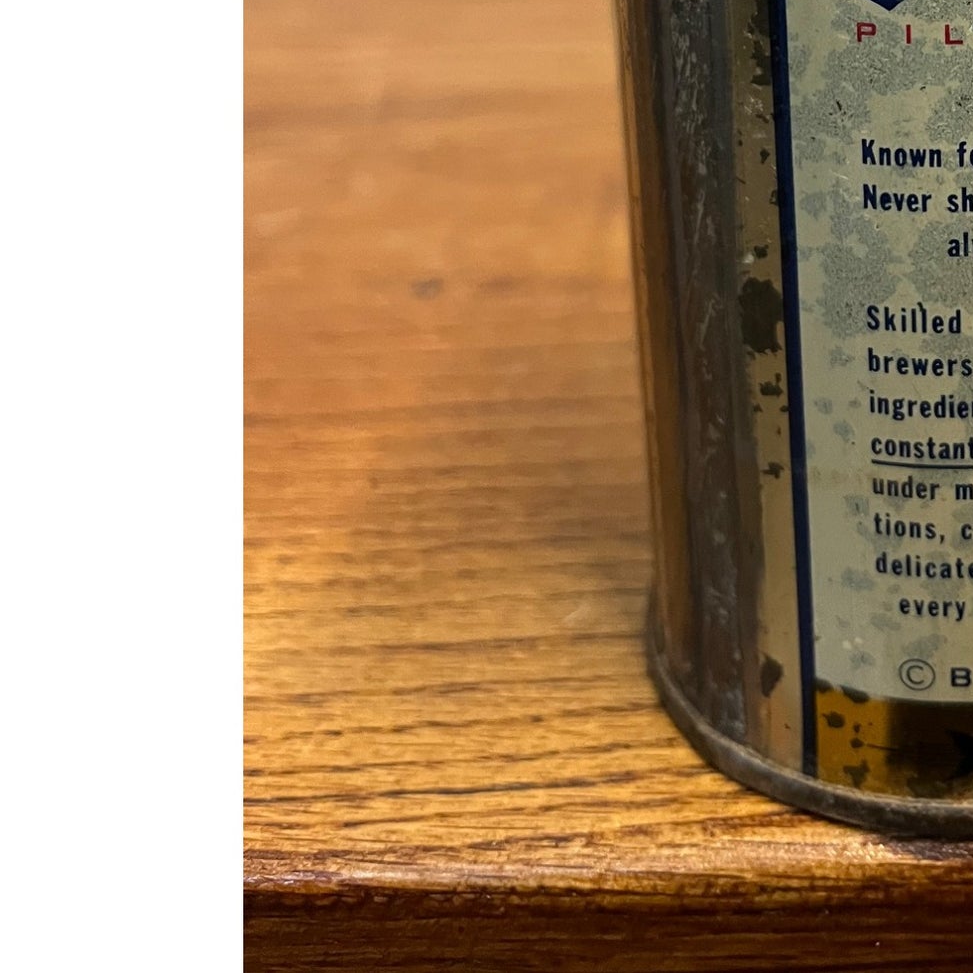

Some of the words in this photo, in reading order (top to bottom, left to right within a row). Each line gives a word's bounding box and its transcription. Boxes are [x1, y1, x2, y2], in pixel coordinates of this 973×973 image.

[861, 138, 942, 167] Known
[863, 183, 932, 212] Never
[867, 304, 961, 334] Skilled
[868, 347, 973, 377] brewers
[872, 476, 940, 500] under
[874, 512, 946, 544] tions,
[899, 597, 966, 622] every
